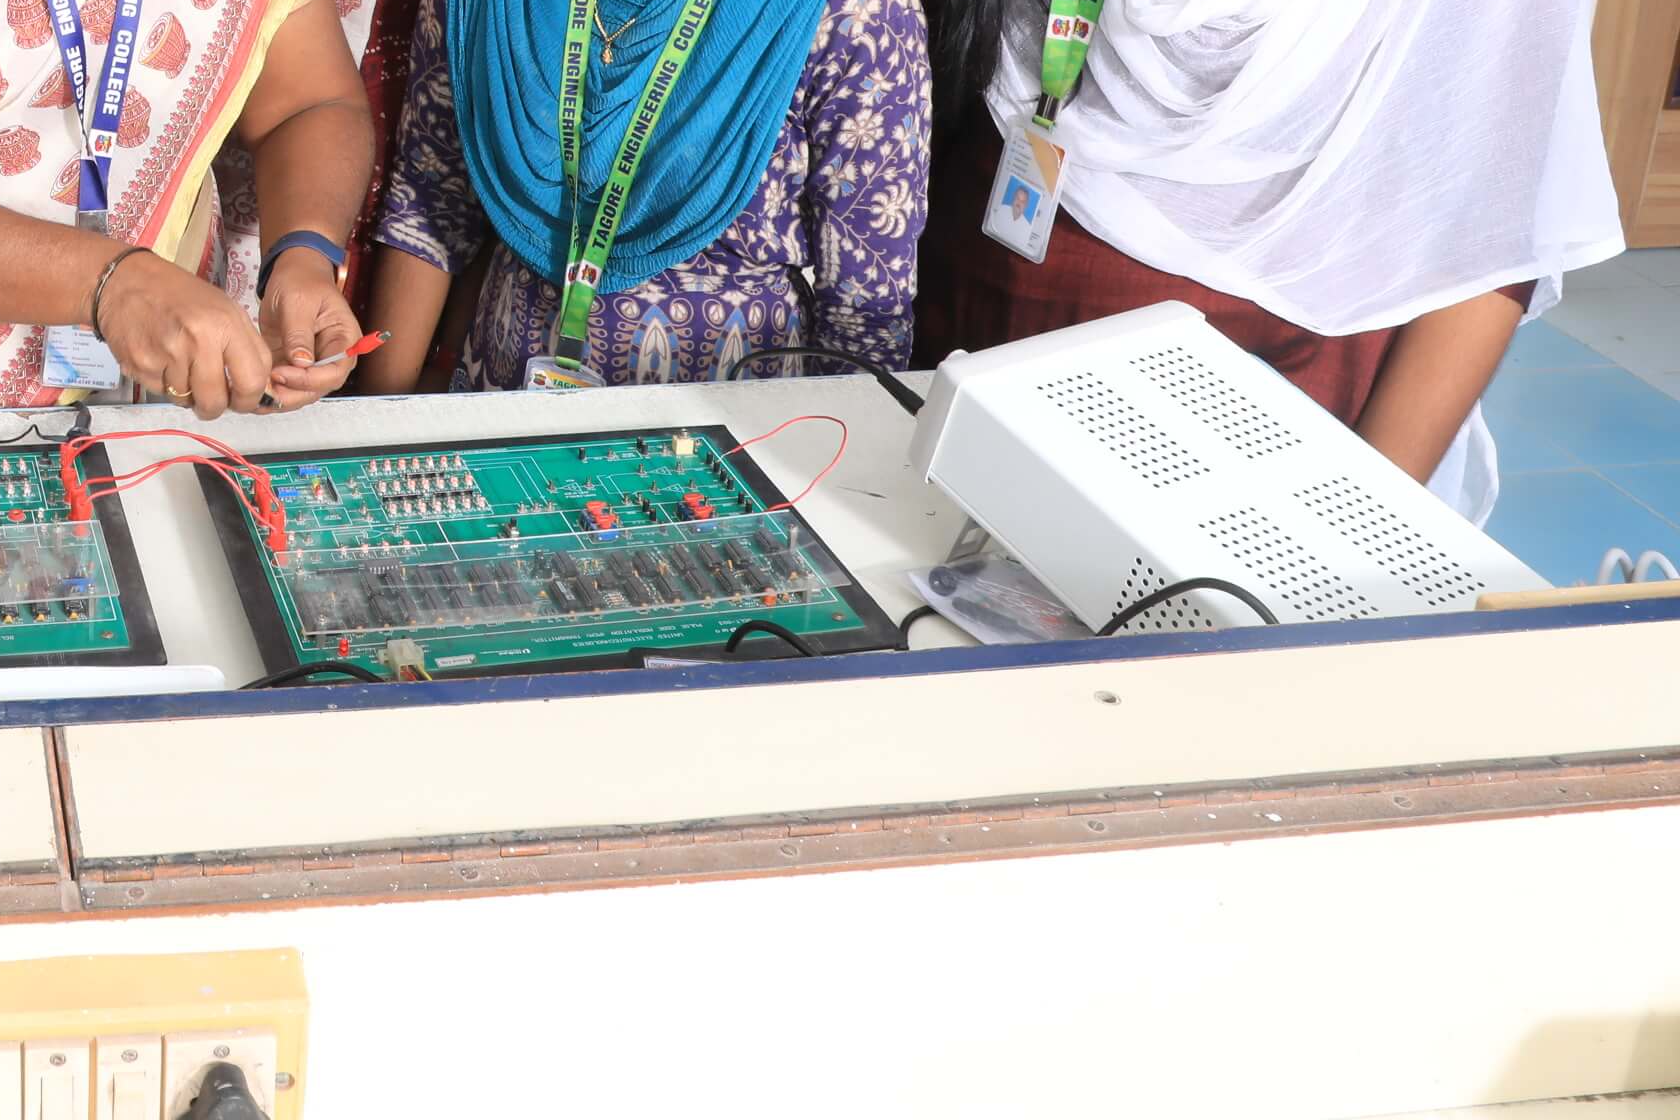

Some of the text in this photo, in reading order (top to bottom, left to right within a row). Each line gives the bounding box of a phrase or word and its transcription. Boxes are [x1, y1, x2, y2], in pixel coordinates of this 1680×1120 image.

[64, 44, 86, 121] AGORE
[102, 30, 133, 118] COLLEGE
[562, 41, 583, 162] ENGINEERING
[592, 183, 625, 251] TAGORE
[617, 59, 678, 176] ENGINEERING
